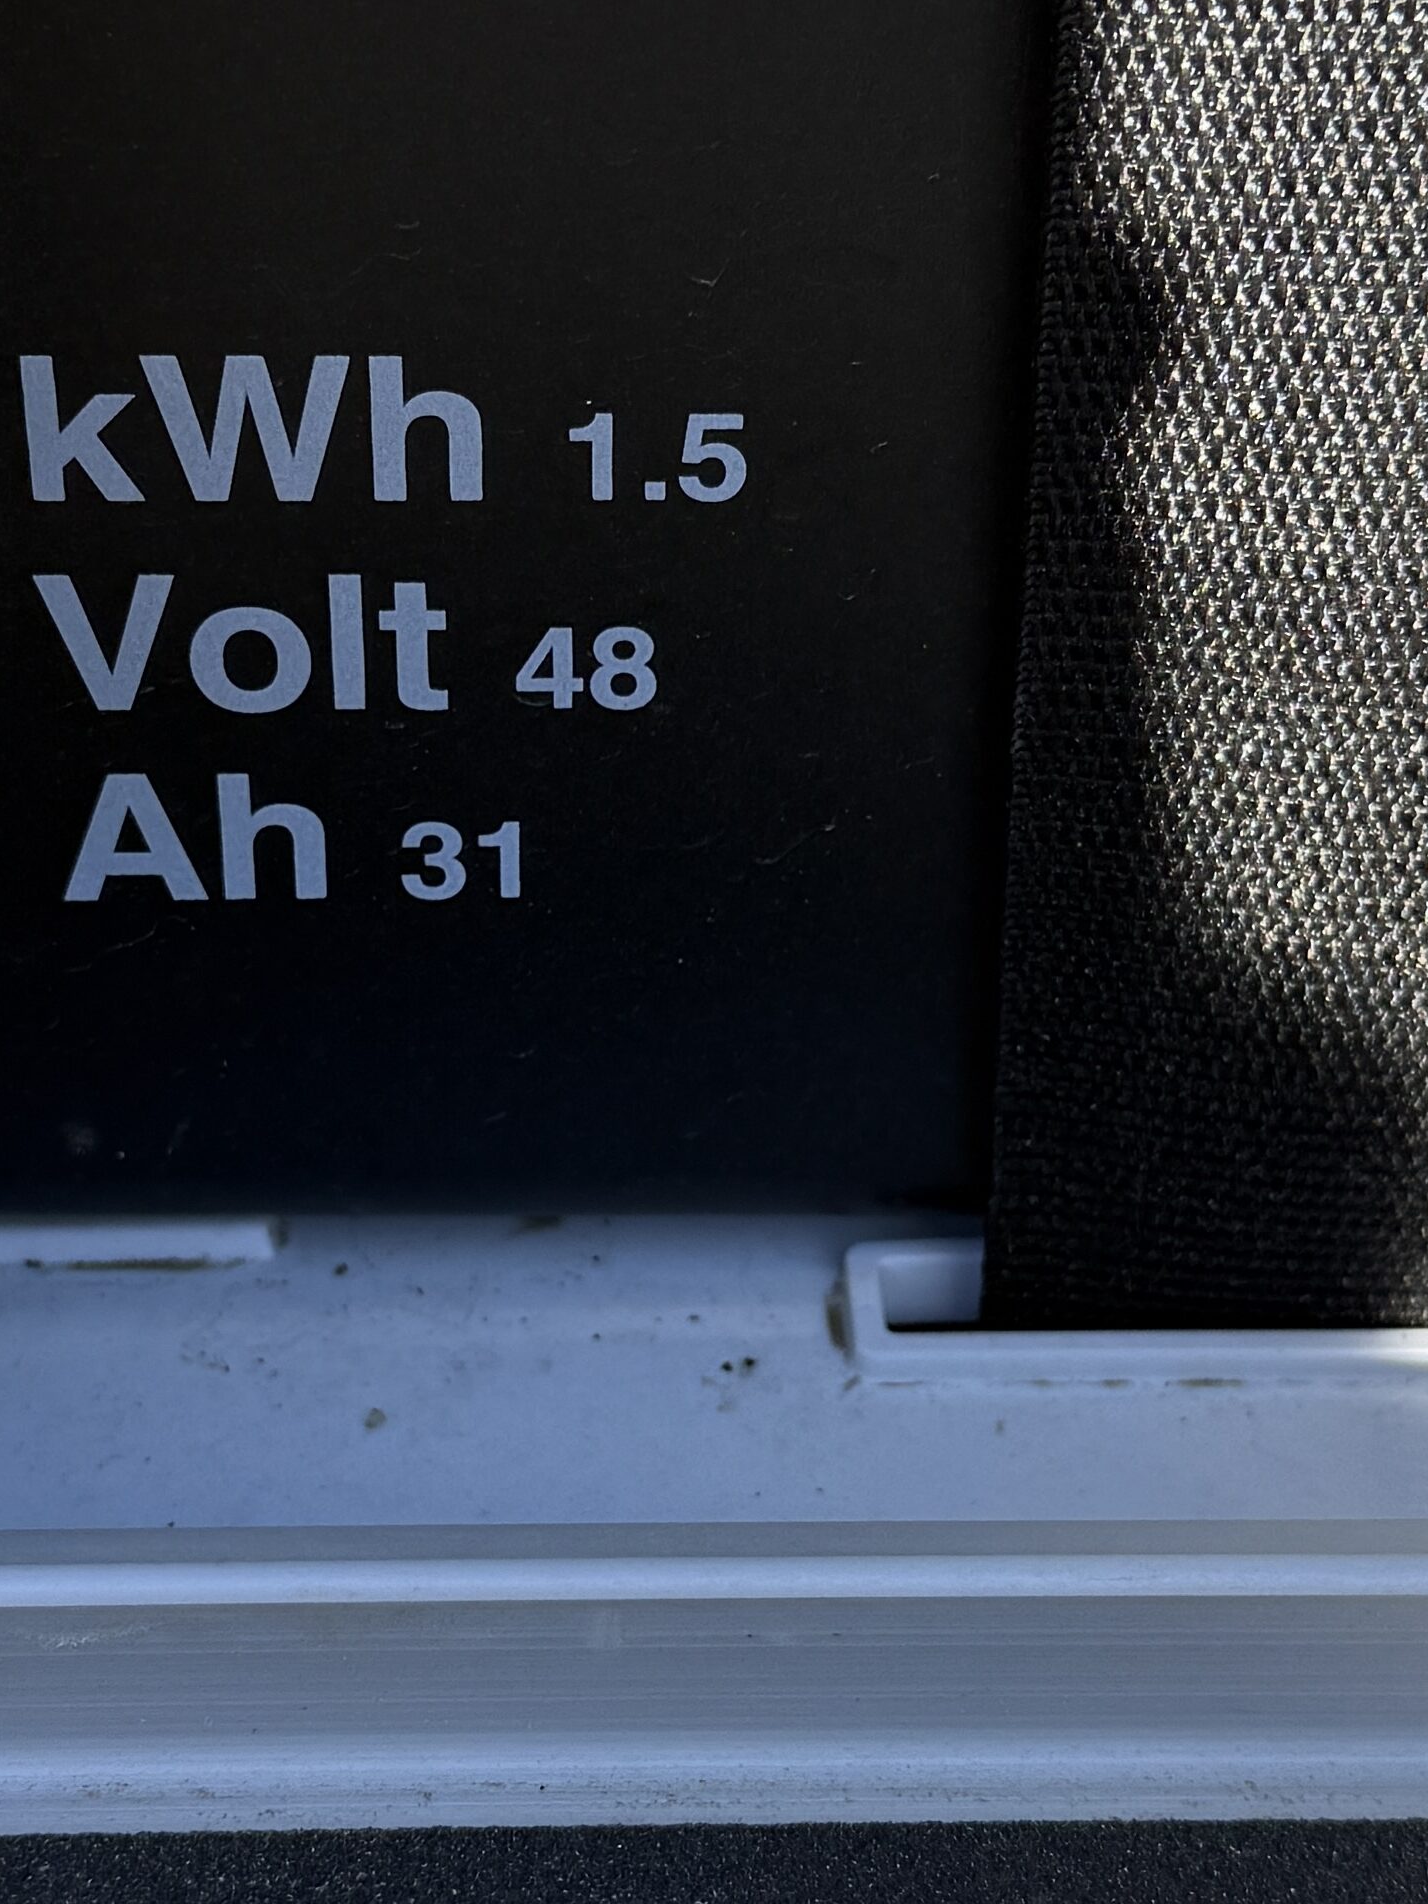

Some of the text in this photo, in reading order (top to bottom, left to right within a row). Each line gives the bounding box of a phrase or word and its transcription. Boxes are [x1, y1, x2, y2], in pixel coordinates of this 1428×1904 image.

[19, 354, 747, 503] kWh 1.5
[32, 574, 658, 714] Volt 48
[64, 773, 521, 903] Ah 31
